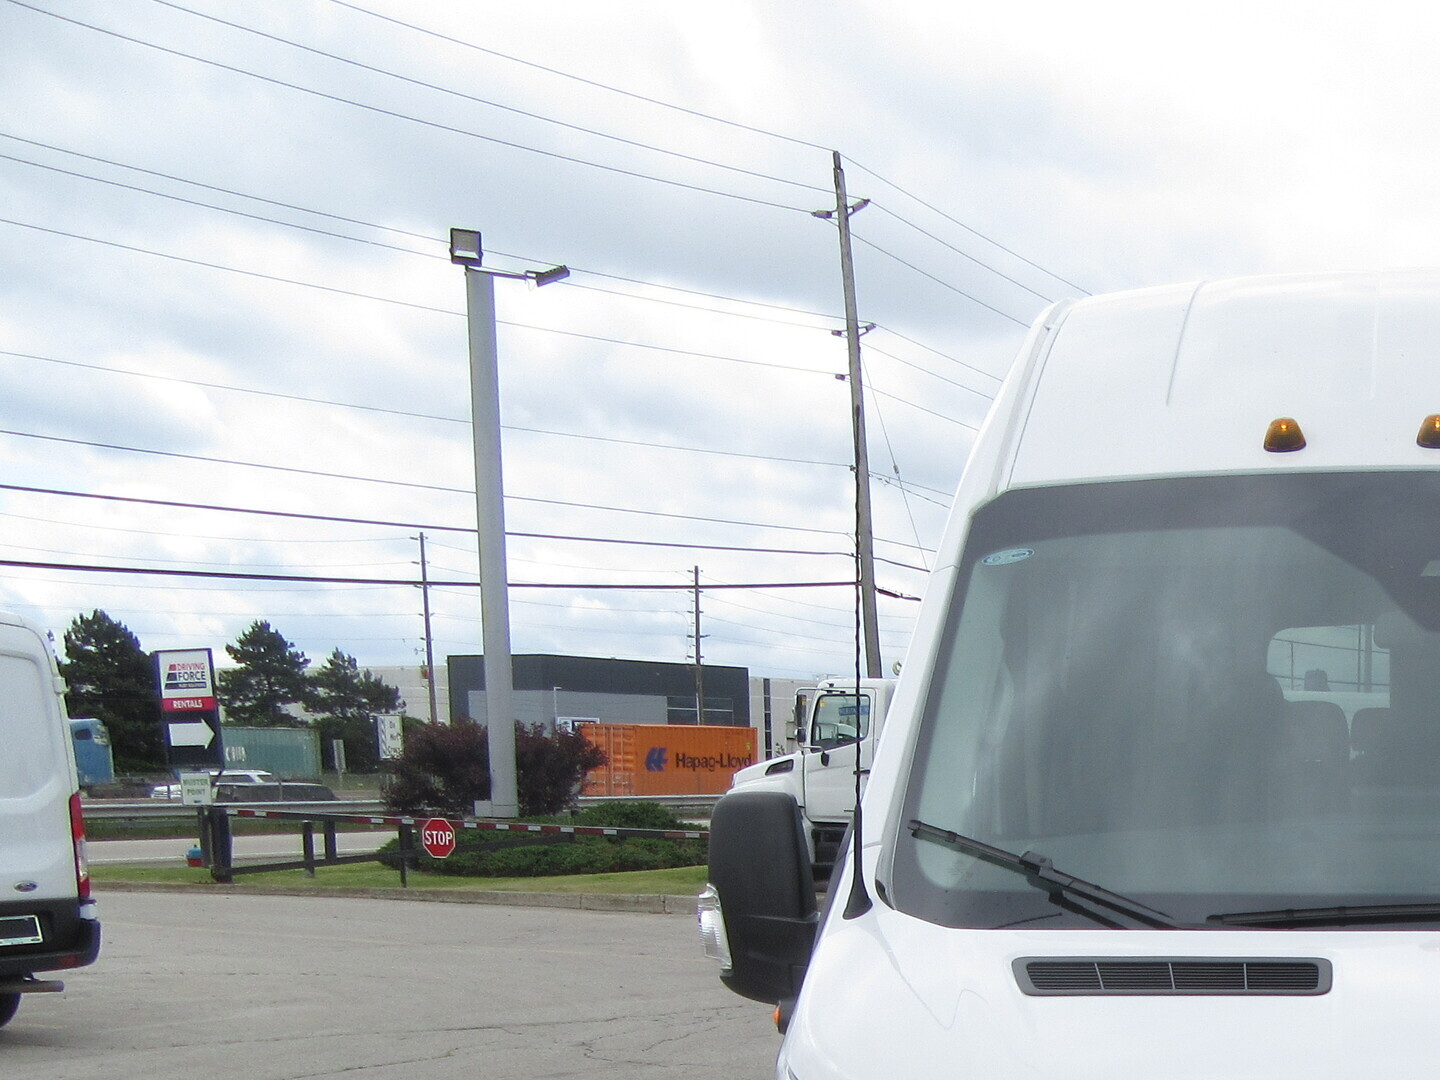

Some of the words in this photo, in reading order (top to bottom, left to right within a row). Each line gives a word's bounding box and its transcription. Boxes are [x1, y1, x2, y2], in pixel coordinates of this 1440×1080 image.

[177, 663, 206, 671] DRIVING
[178, 671, 206, 681] FORCE
[173, 700, 203, 709] RENTALS
[675, 753, 752, 772] Hapag-Lloyd
[424, 830, 453, 846] STOP
